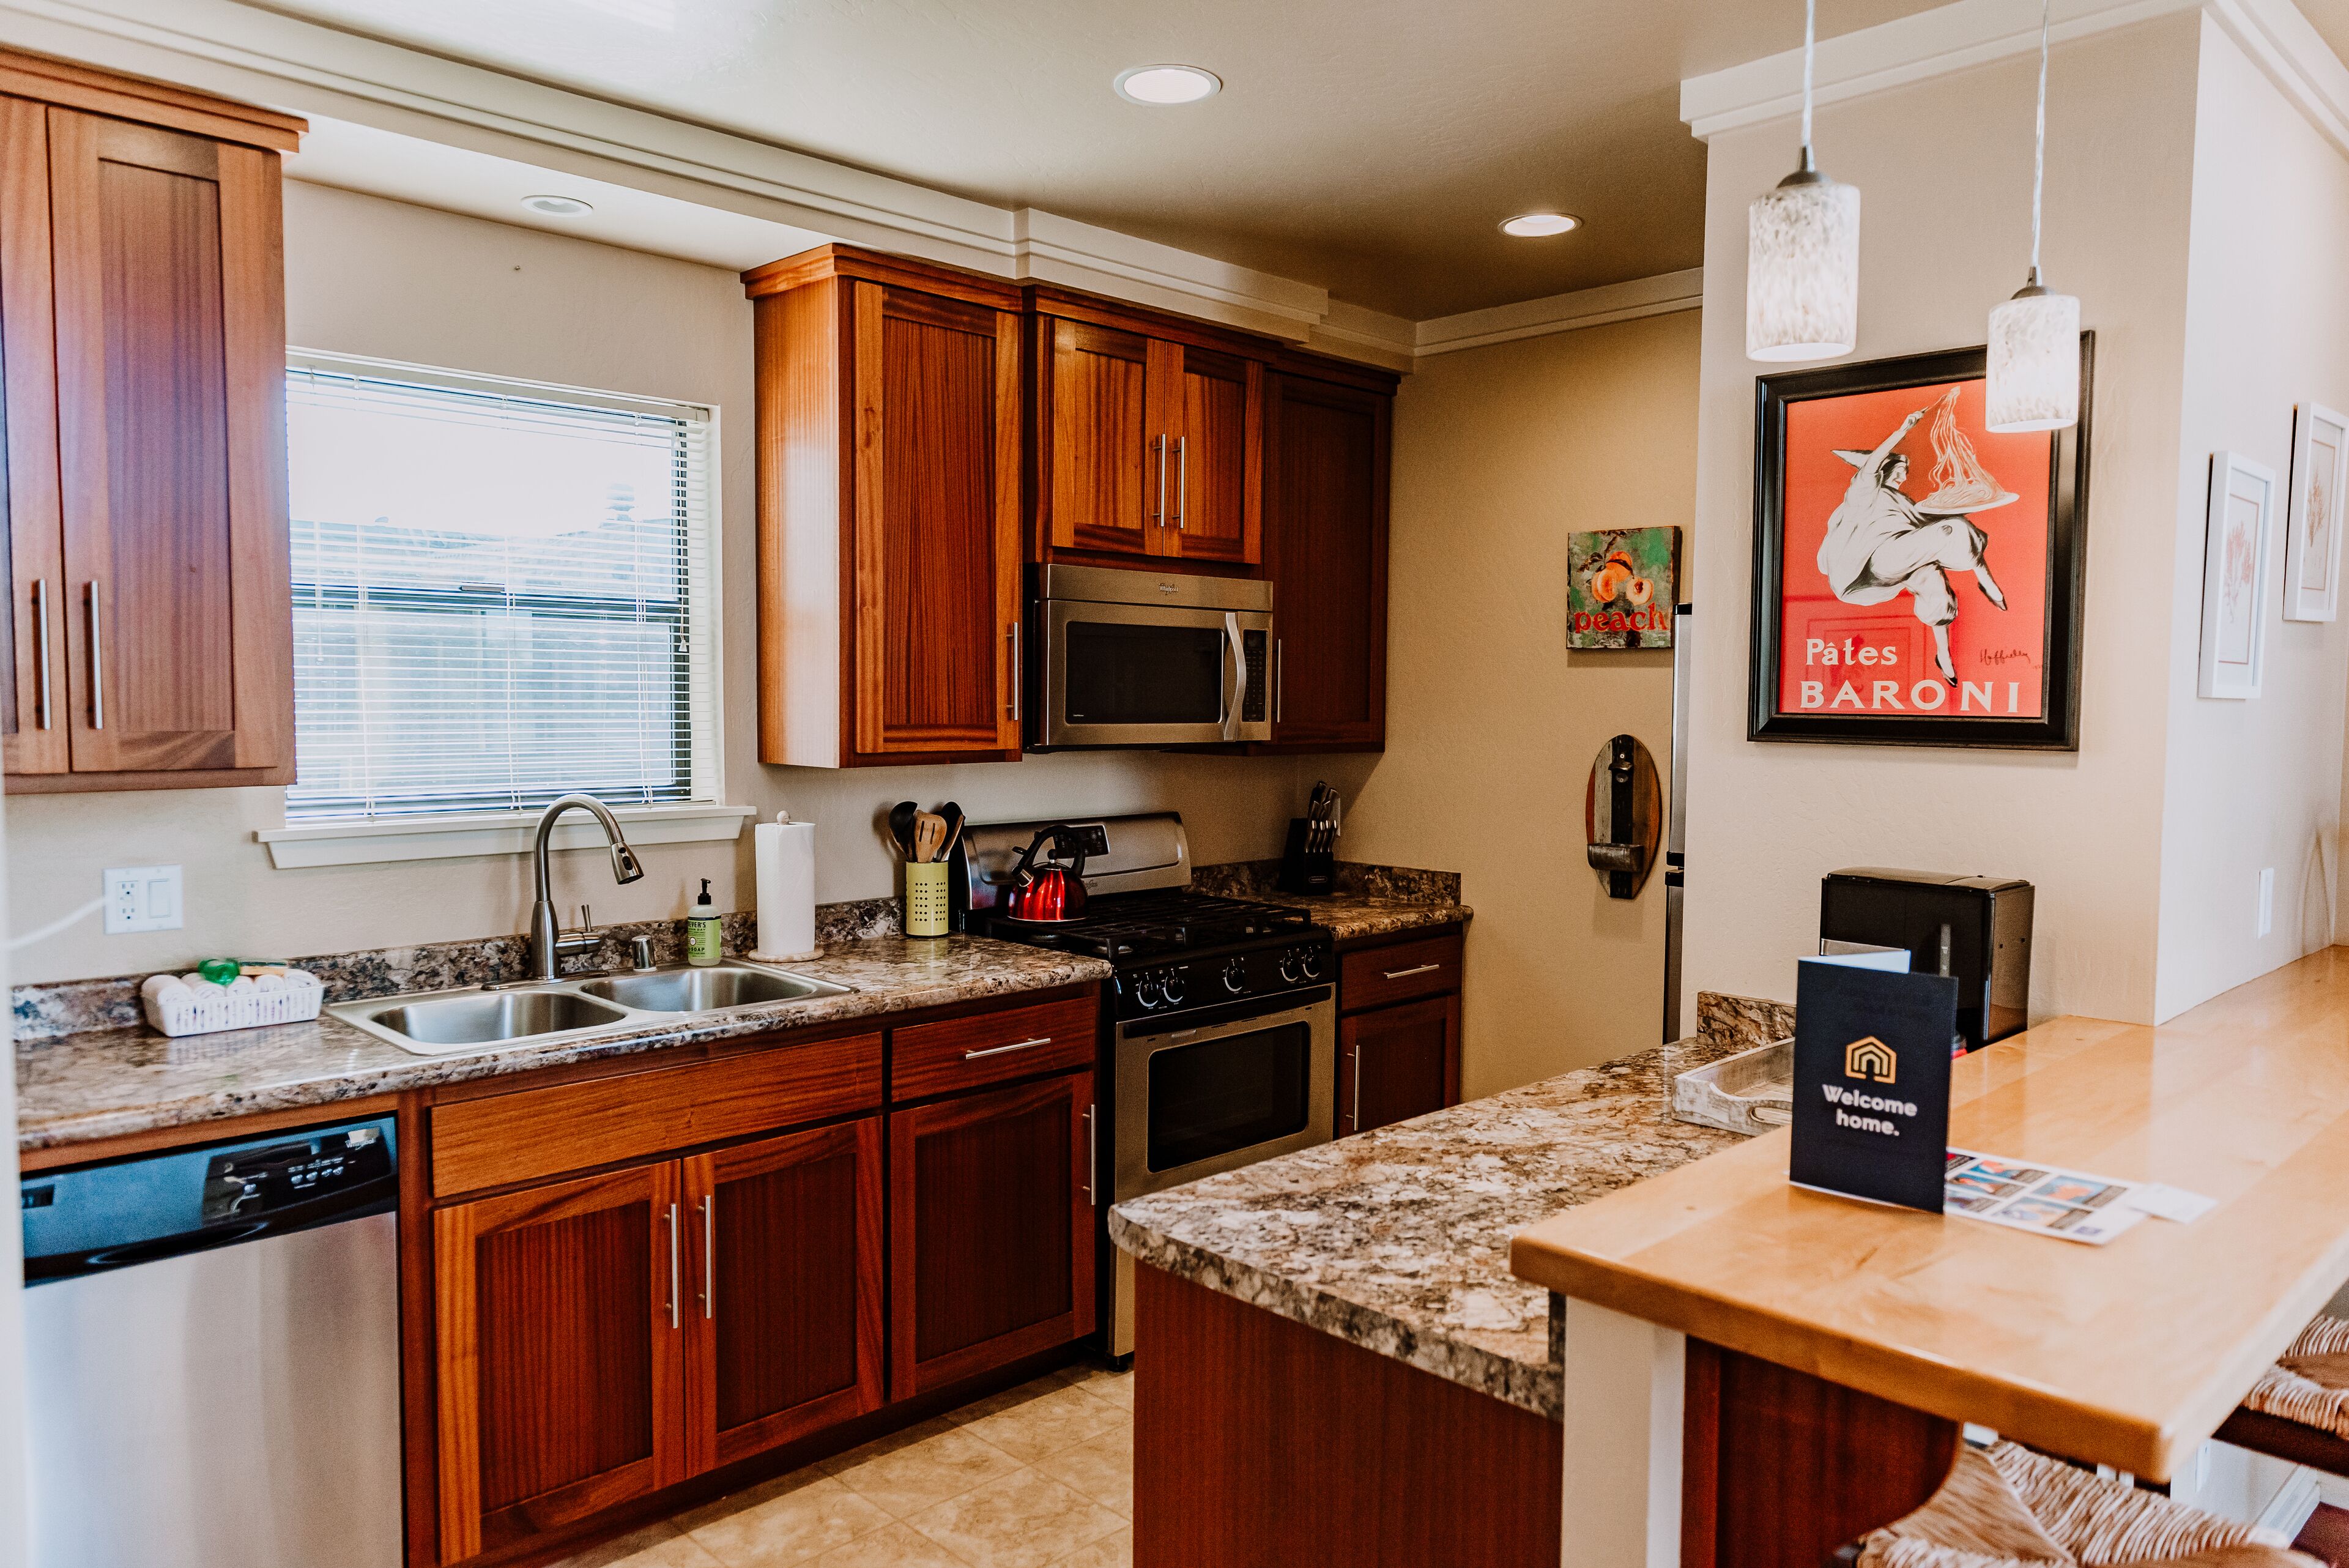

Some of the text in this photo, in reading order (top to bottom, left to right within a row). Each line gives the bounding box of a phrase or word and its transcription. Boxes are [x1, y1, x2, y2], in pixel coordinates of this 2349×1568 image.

[1574, 602, 1668, 634] peach
[1806, 638, 1898, 666] Pâtes
[1800, 680, 2020, 713] BARONI
[1822, 1083, 1918, 1117] Welcome
[1836, 1108, 1900, 1137] home.
